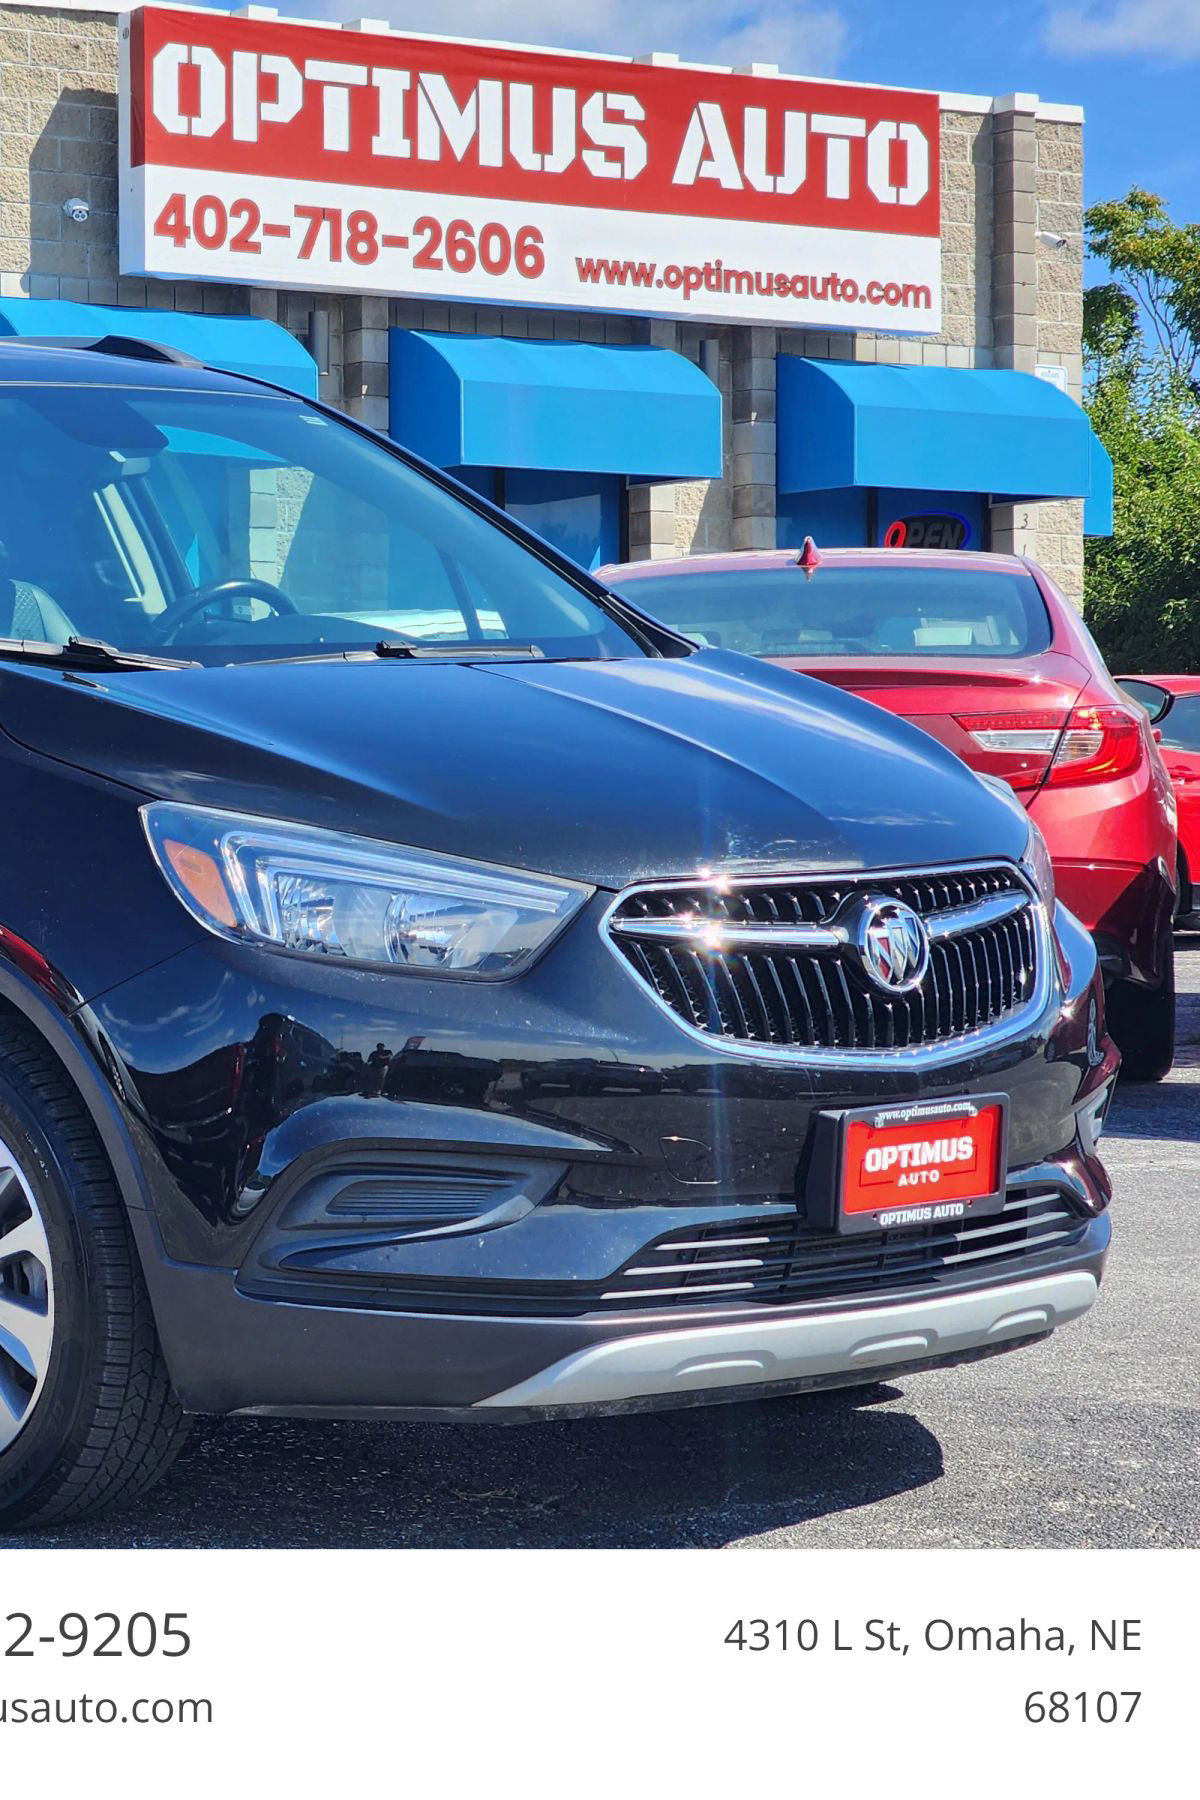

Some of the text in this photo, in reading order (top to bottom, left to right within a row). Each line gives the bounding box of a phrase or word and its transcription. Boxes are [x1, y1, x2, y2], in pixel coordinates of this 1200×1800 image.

[152, 42, 930, 207] OPTIMUS AUTO
[154, 193, 546, 280] 402-718-2606
[575, 256, 933, 310] www.optimusauto.com
[884, 521, 962, 548] OPEN
[878, 1102, 971, 1121] www.optimusauto.com
[865, 1136, 974, 1172] OPTIMUS
[898, 1170, 940, 1186] AUTO
[879, 1202, 964, 1226] OPTIMUS AUTO
